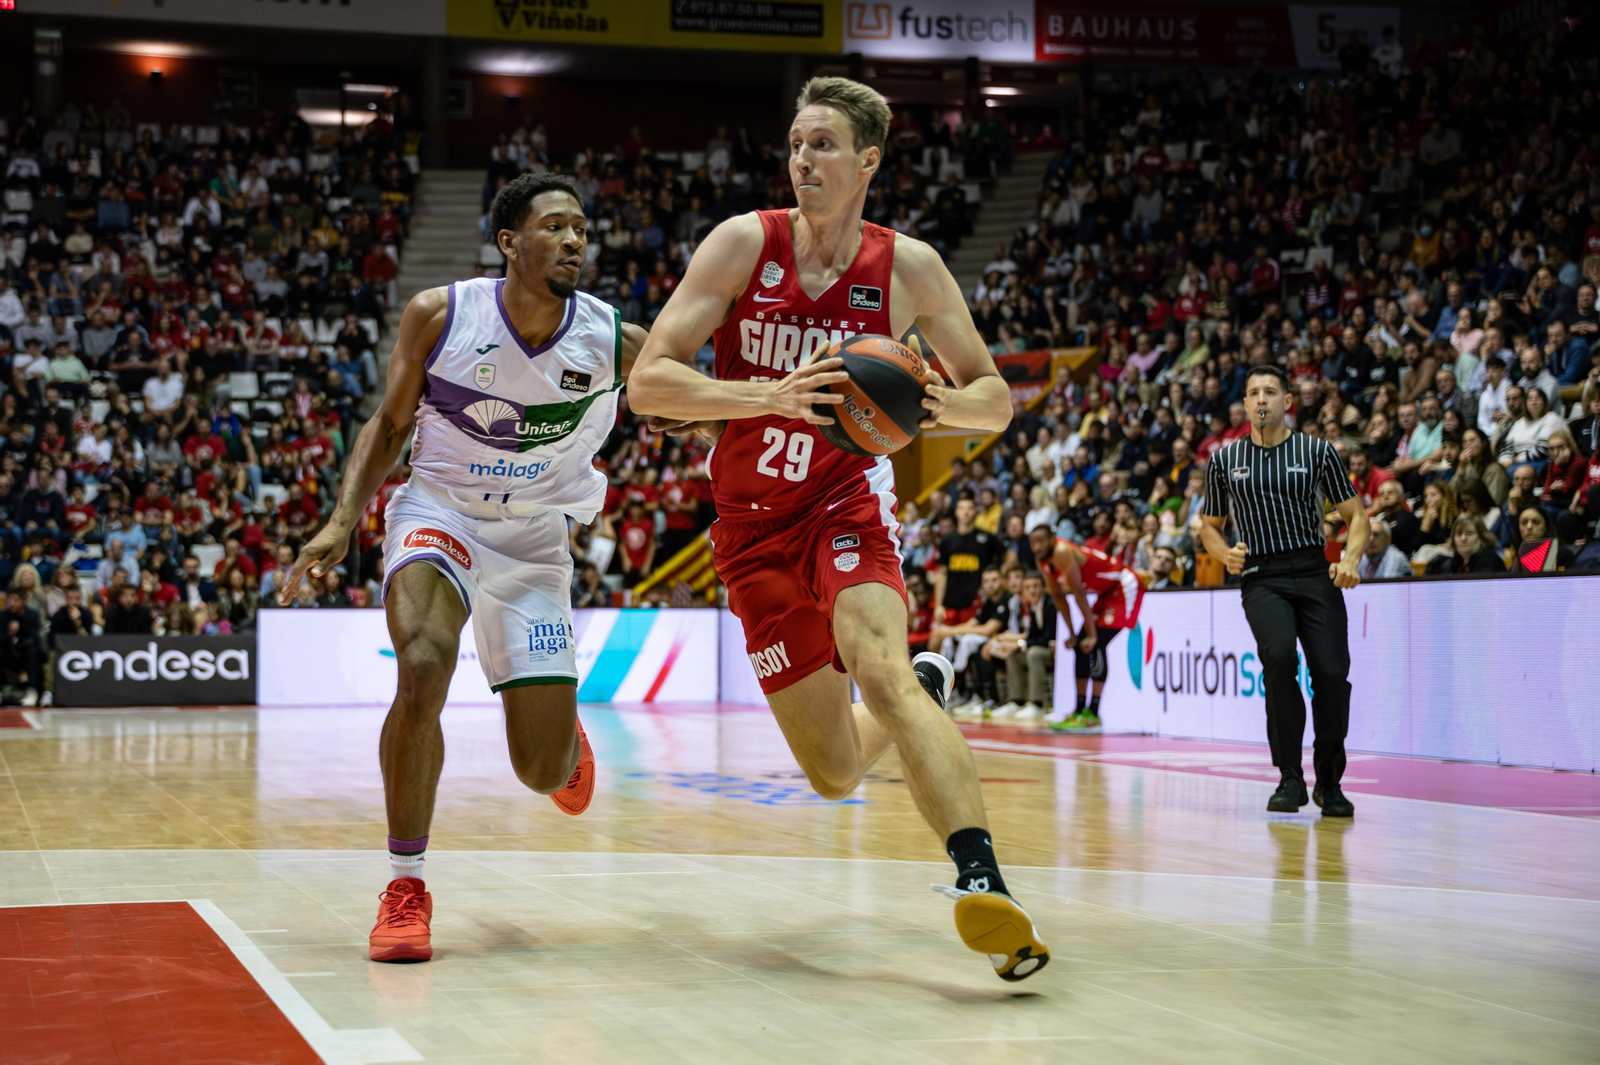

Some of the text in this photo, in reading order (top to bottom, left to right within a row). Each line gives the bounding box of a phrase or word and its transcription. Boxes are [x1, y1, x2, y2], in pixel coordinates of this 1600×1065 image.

[522, 10, 609, 31] Viñolas
[898, 8, 1028, 43] fustech
[1047, 14, 1199, 41] BAUHAUS
[1318, 13, 1335, 52] 5
[852, 292, 866, 300] liga
[852, 299, 879, 308] endesa
[562, 382, 588, 391] endesa
[563, 375, 576, 384] liga
[757, 426, 814, 482] 29
[836, 539, 854, 548] acb
[58, 641, 249, 681] endesa
